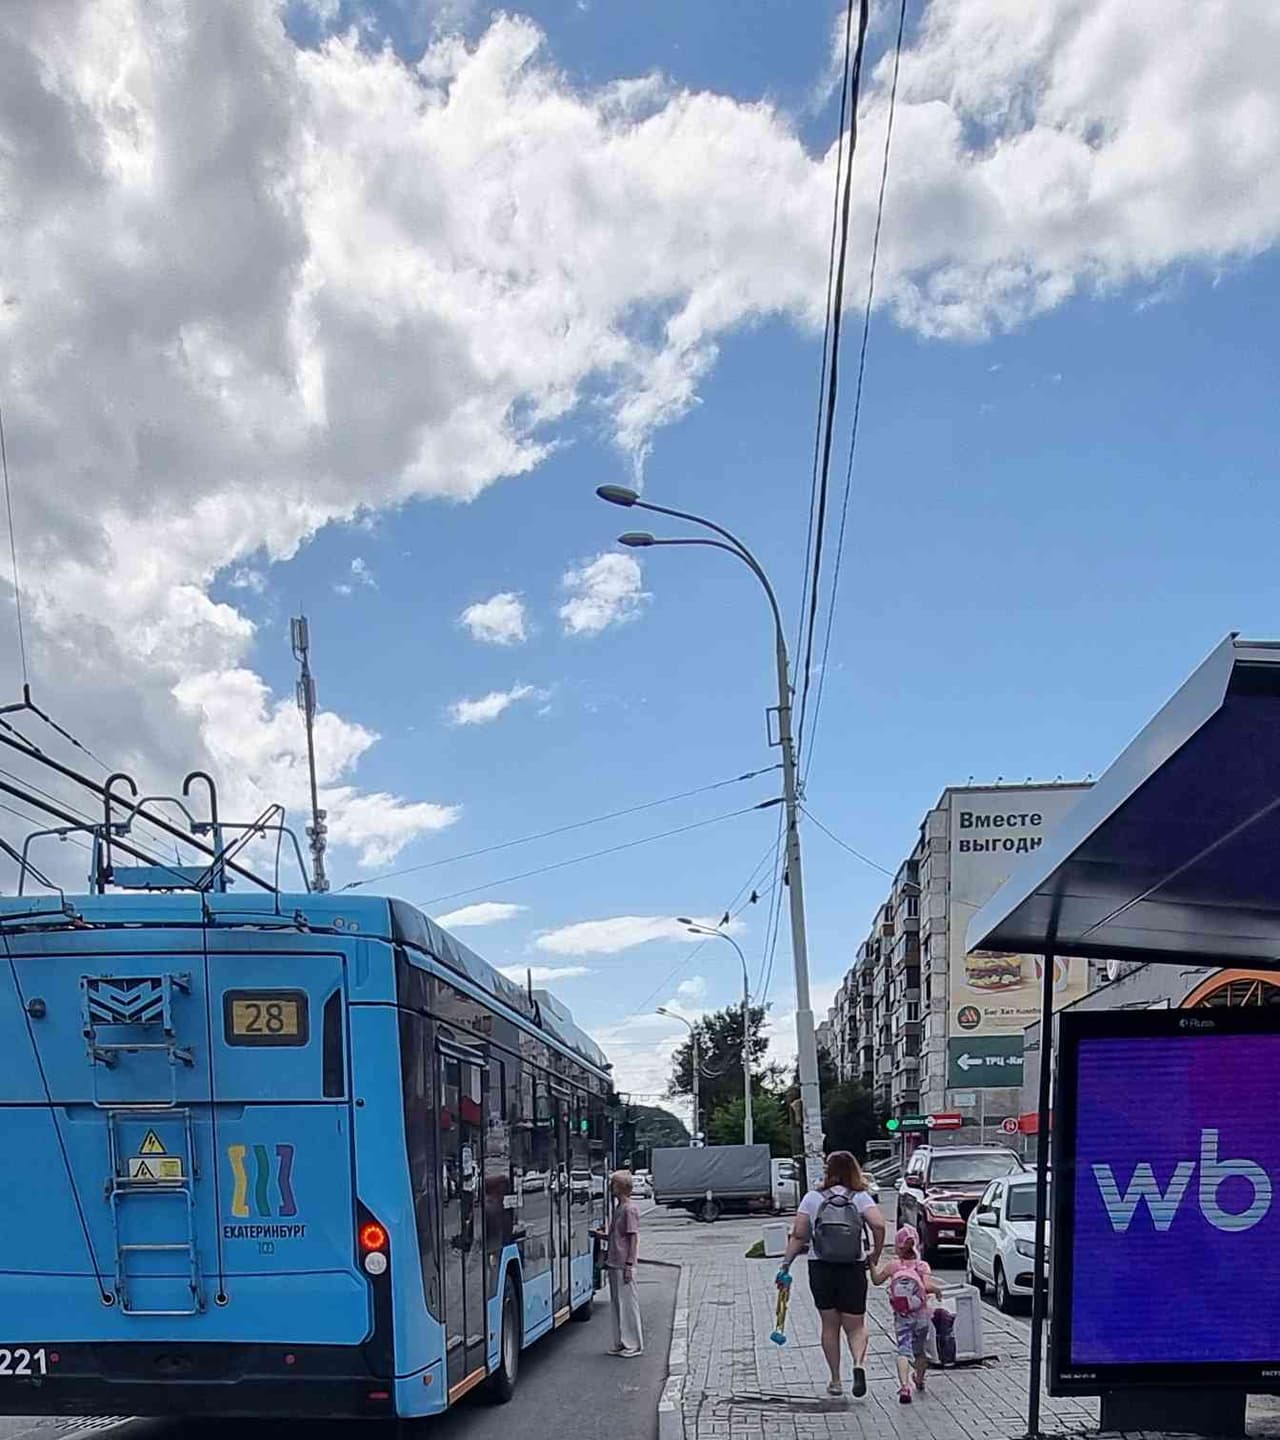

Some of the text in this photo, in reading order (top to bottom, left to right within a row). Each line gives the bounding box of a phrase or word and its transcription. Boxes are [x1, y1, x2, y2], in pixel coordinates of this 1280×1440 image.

[959, 811, 1042, 829] Вместе
[245, 1003, 284, 1033] 28
[1091, 1128, 1272, 1232] wb
[223, 1224, 306, 1239] ЕКАТЕРИНБУРГ
